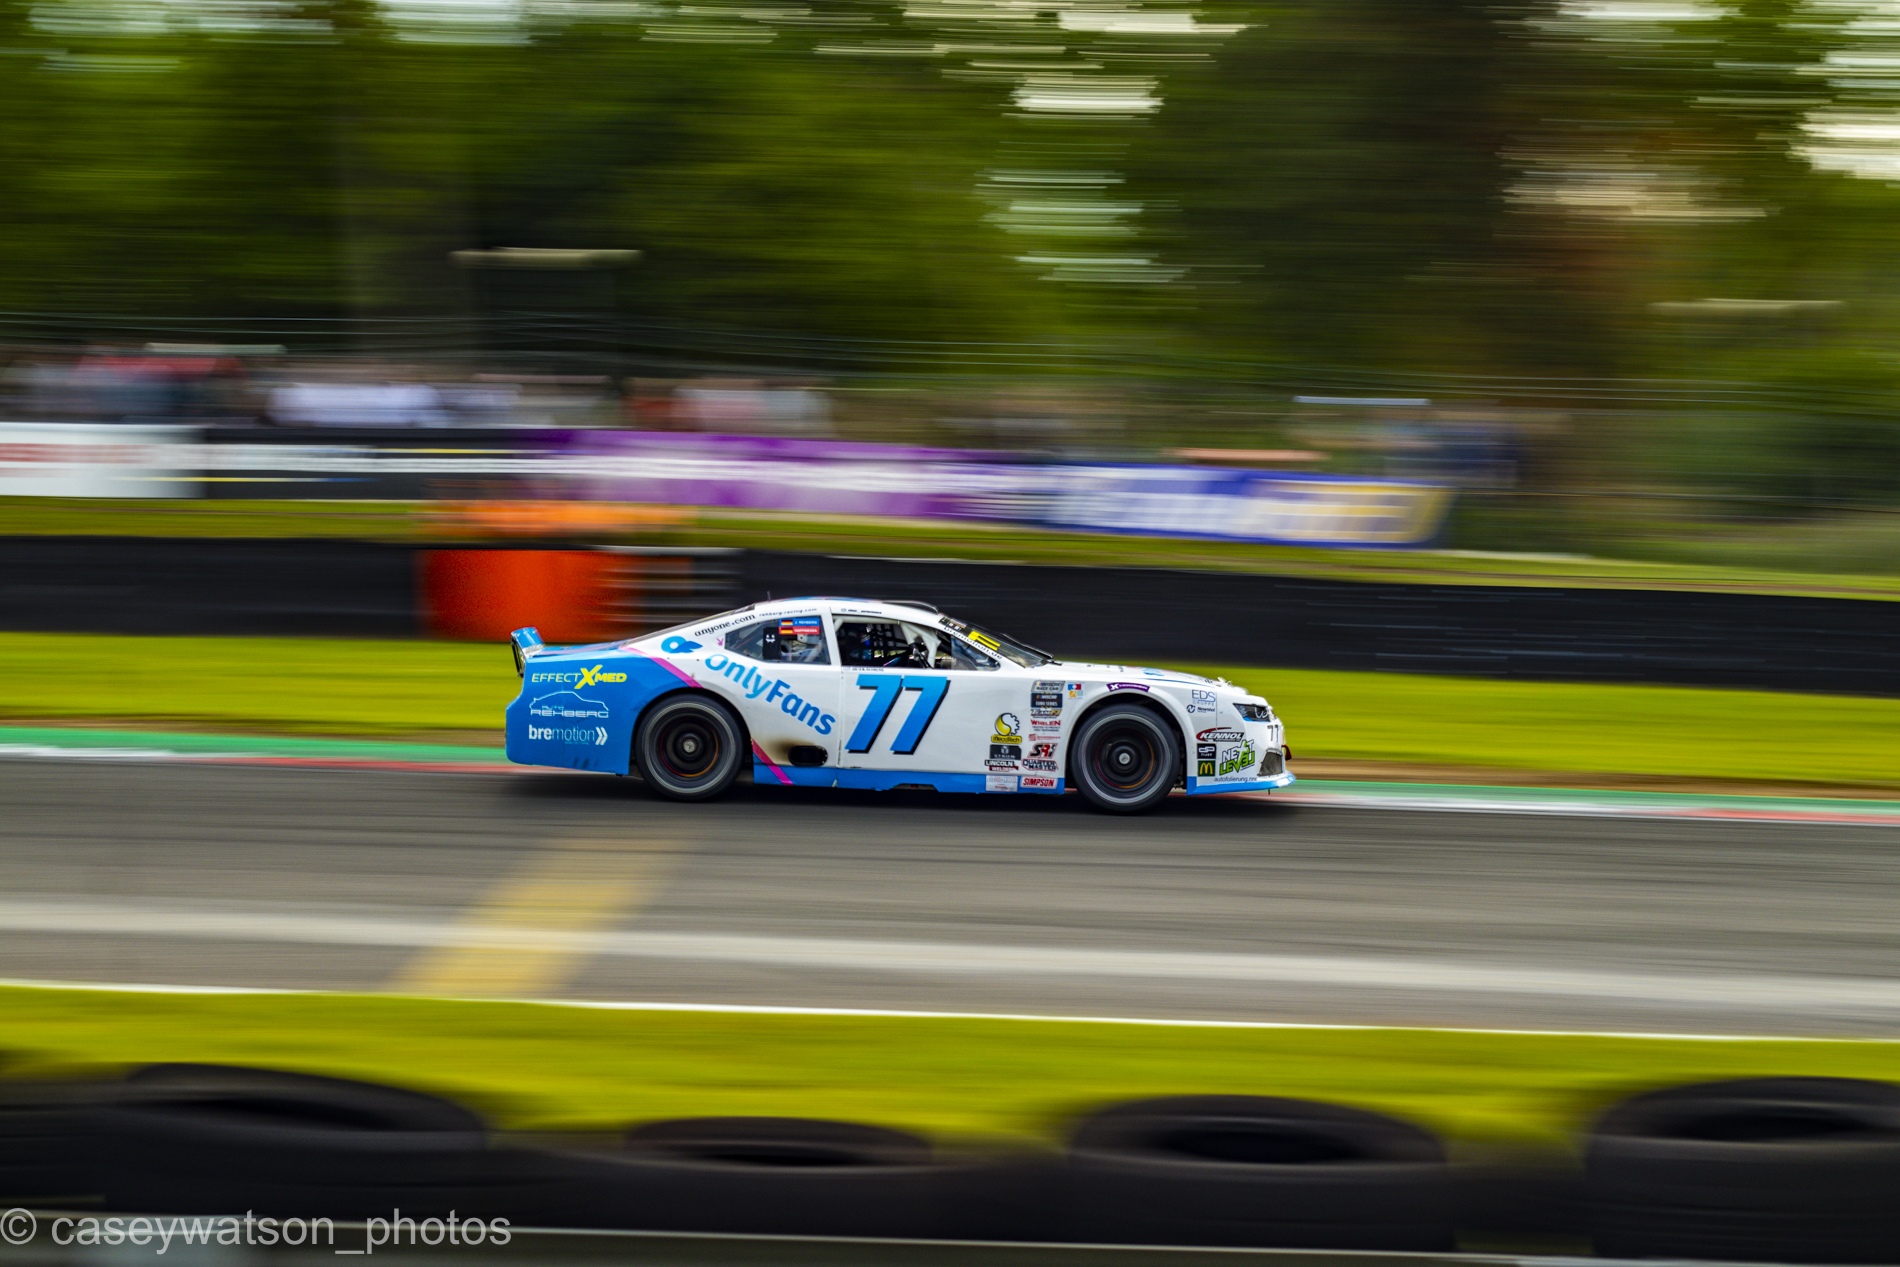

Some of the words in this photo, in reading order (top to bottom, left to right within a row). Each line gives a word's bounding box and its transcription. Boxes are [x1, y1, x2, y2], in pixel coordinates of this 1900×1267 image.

[694, 613, 756, 637] anyone.com
[705, 653, 836, 735] OnlyFans
[1191, 689, 1216, 703] EDS
[530, 709, 609, 718] REHBERG
[844, 674, 951, 755] 77
[528, 724, 596, 742] bremotion
[1023, 777, 1055, 787] SIMPSON
